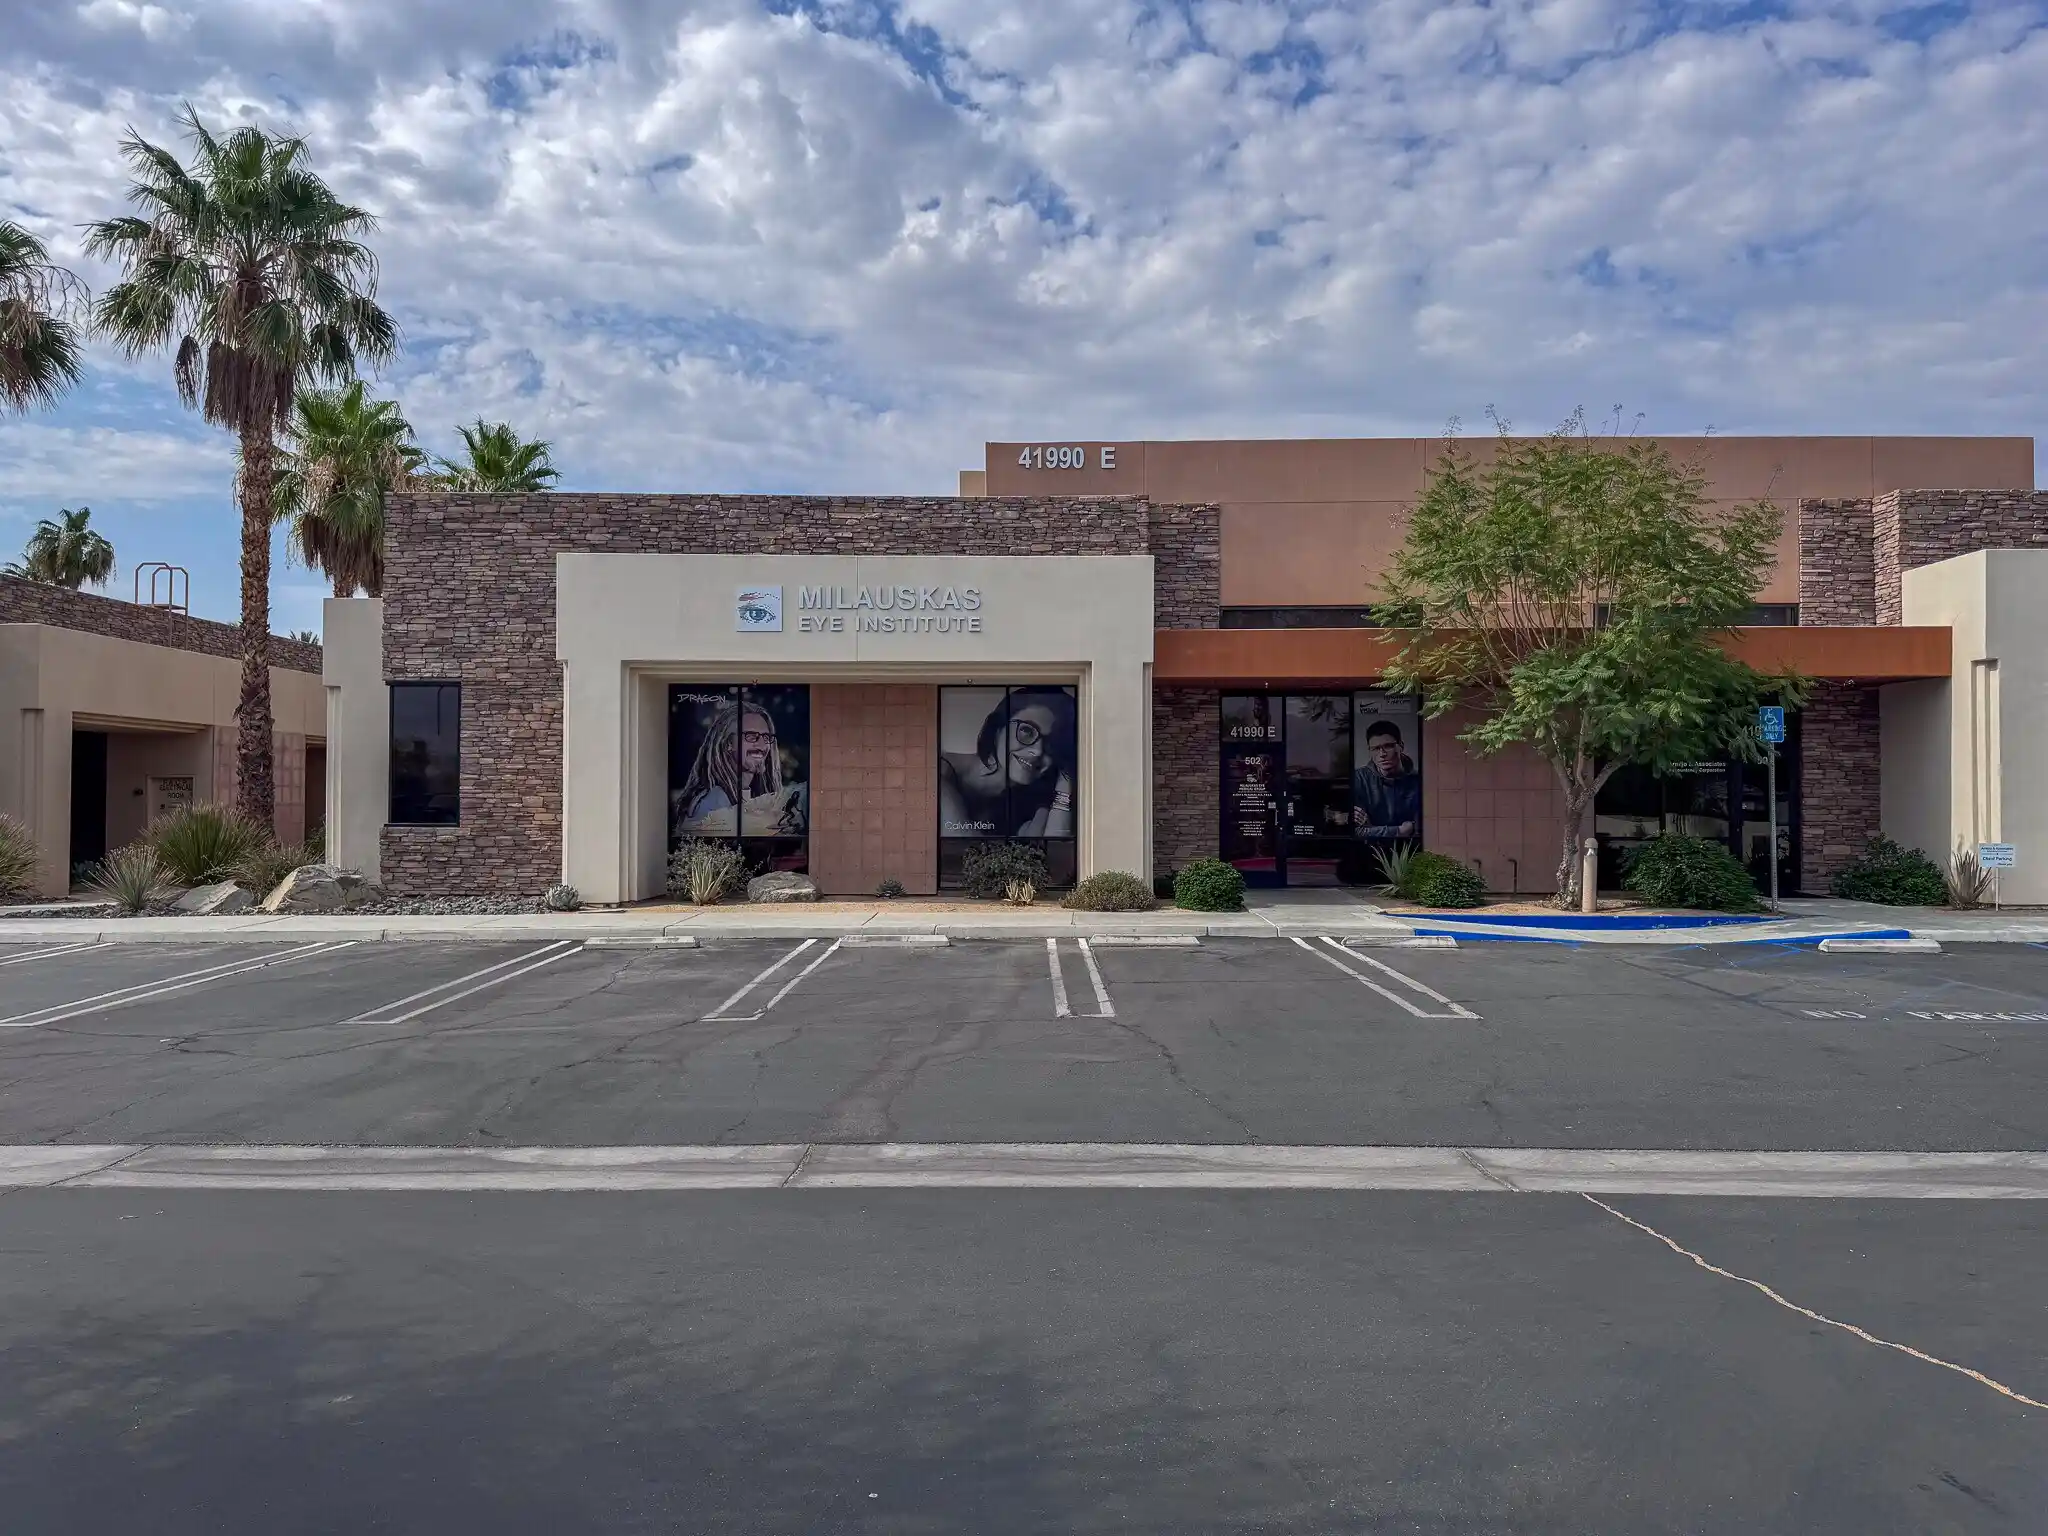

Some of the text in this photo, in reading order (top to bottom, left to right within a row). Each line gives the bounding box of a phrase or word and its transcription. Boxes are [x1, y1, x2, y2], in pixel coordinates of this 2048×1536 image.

[1018, 446, 1116, 469] 41990 E
[799, 586, 981, 610] MILAUSKAS
[799, 616, 982, 633] EYE INSTITUTE
[1230, 726, 1276, 737] 41990 E
[1244, 756, 1261, 765] 502
[944, 820, 995, 830] Calvin Klein
